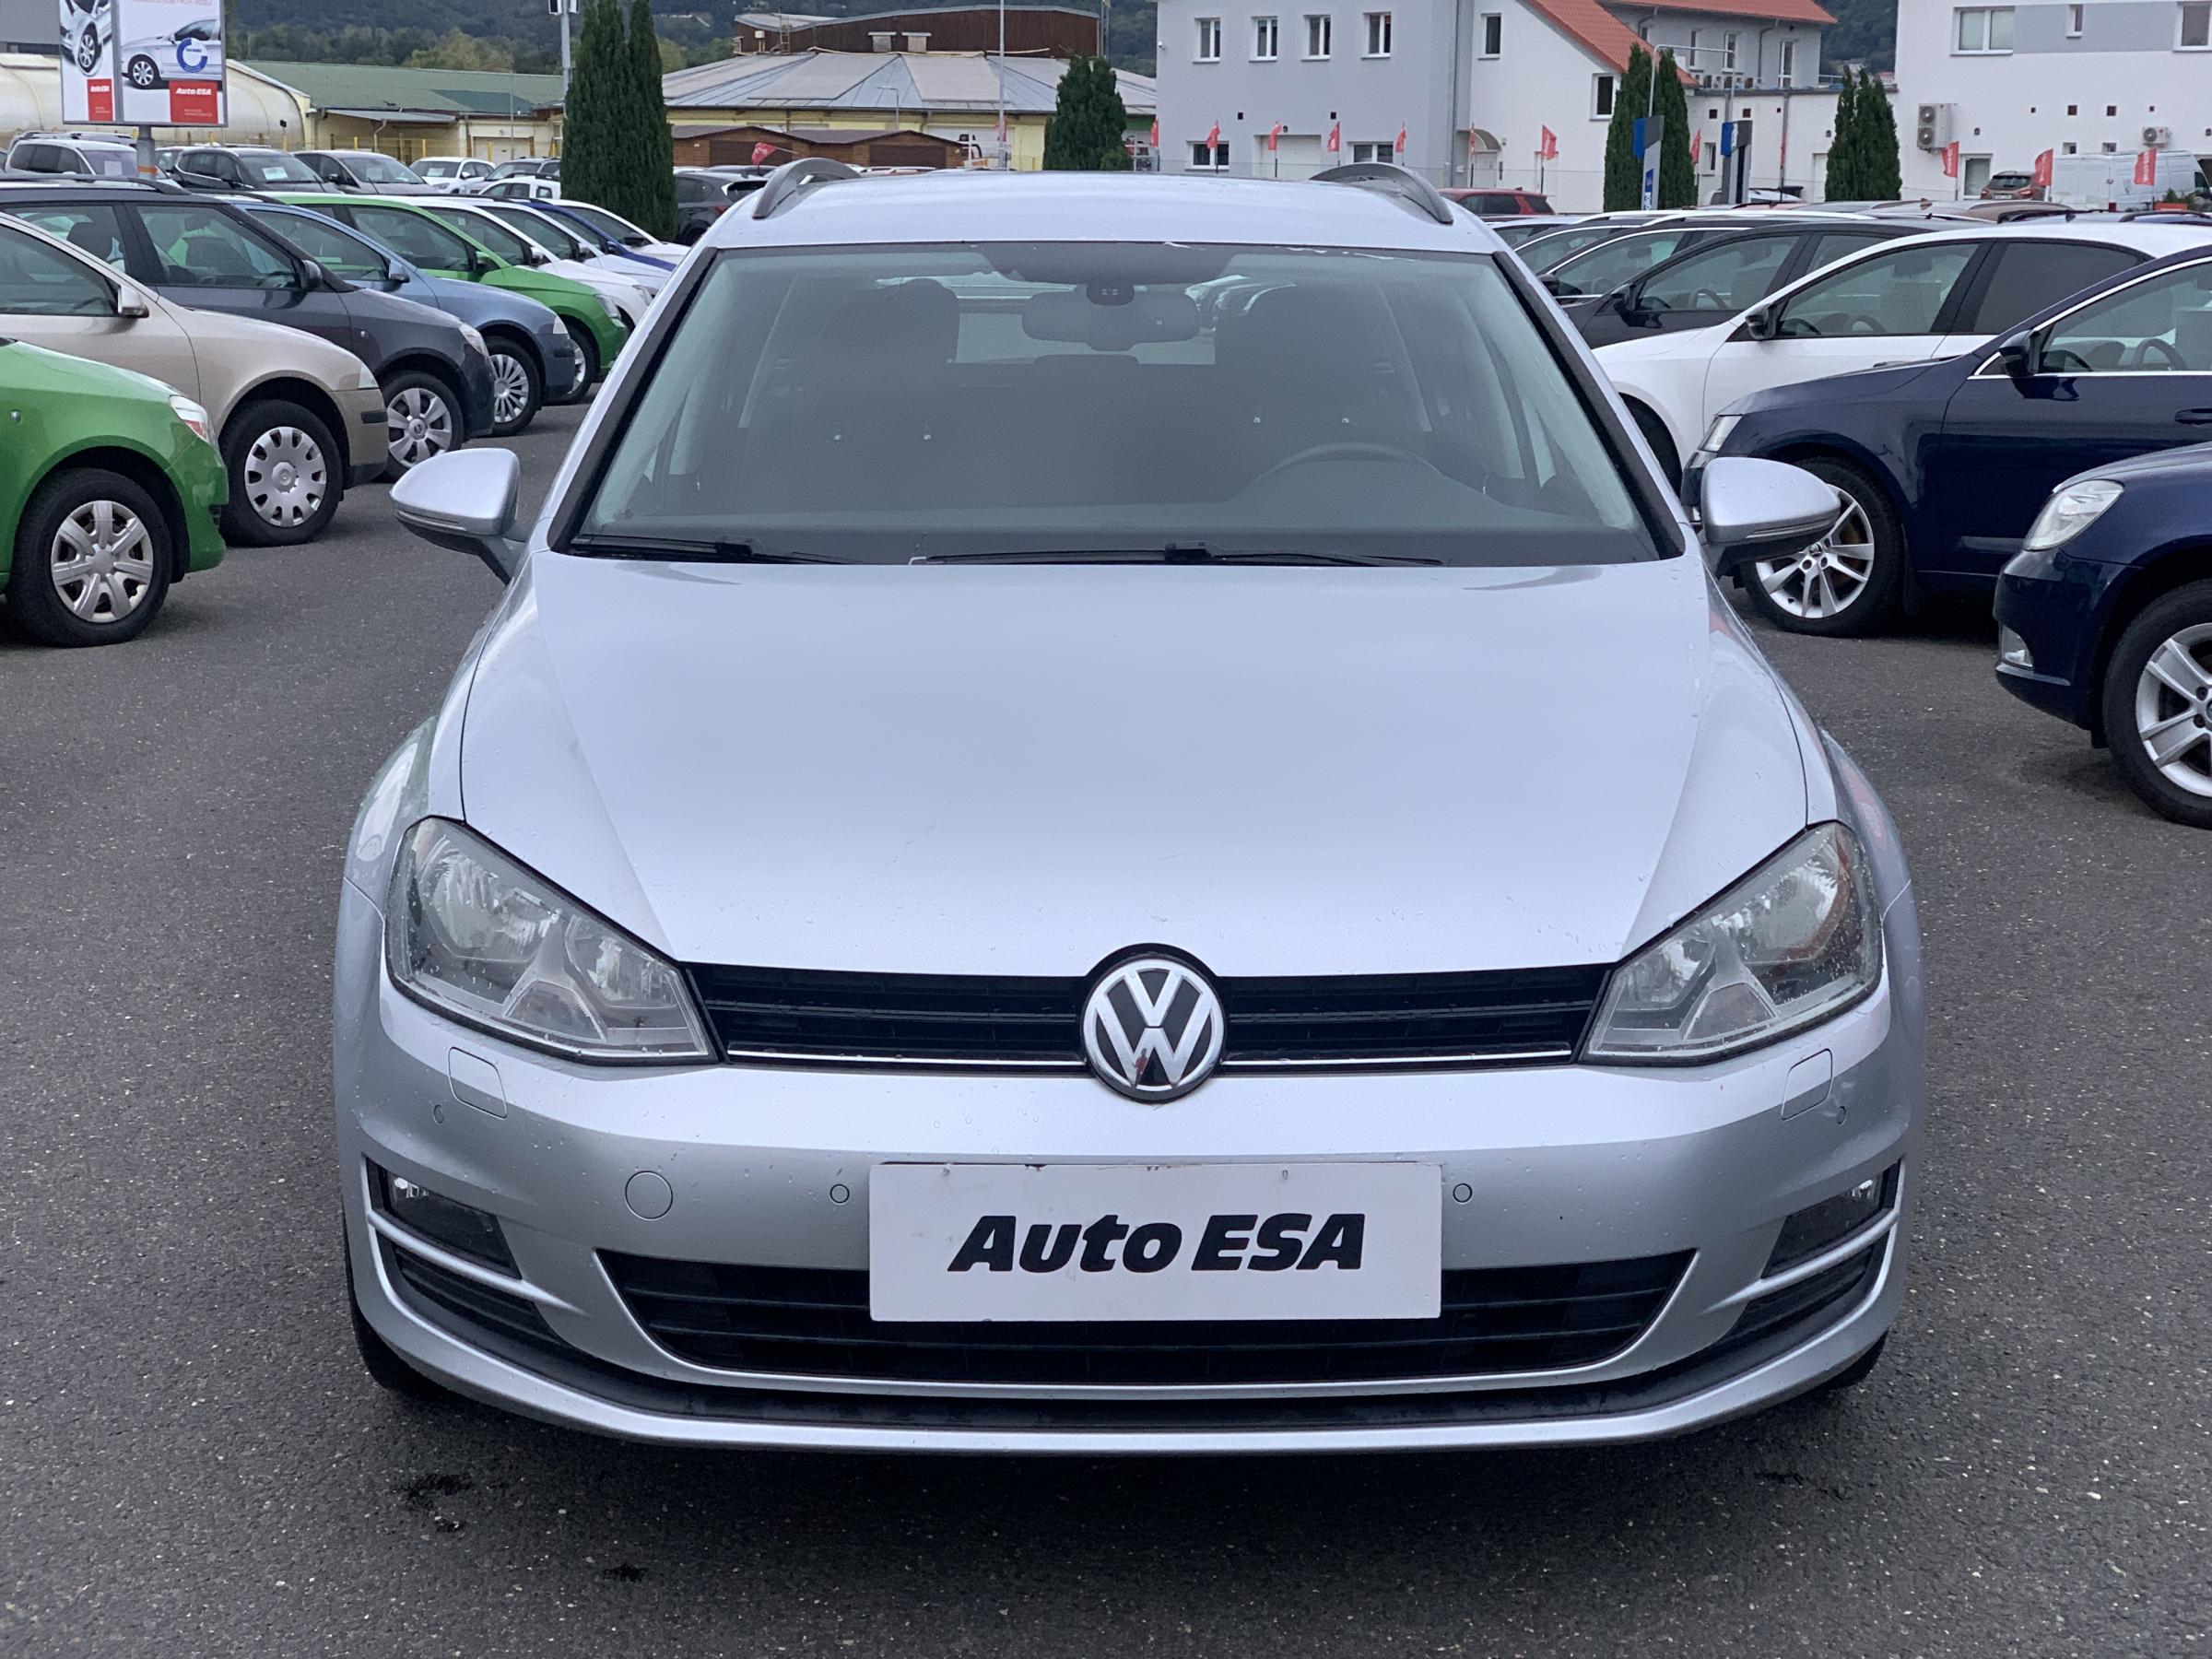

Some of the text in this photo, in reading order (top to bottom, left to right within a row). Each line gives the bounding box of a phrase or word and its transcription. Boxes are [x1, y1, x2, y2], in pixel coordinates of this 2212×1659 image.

[1088, 959, 1221, 1090] VW
[947, 1212, 1366, 1274] Auto ESA
